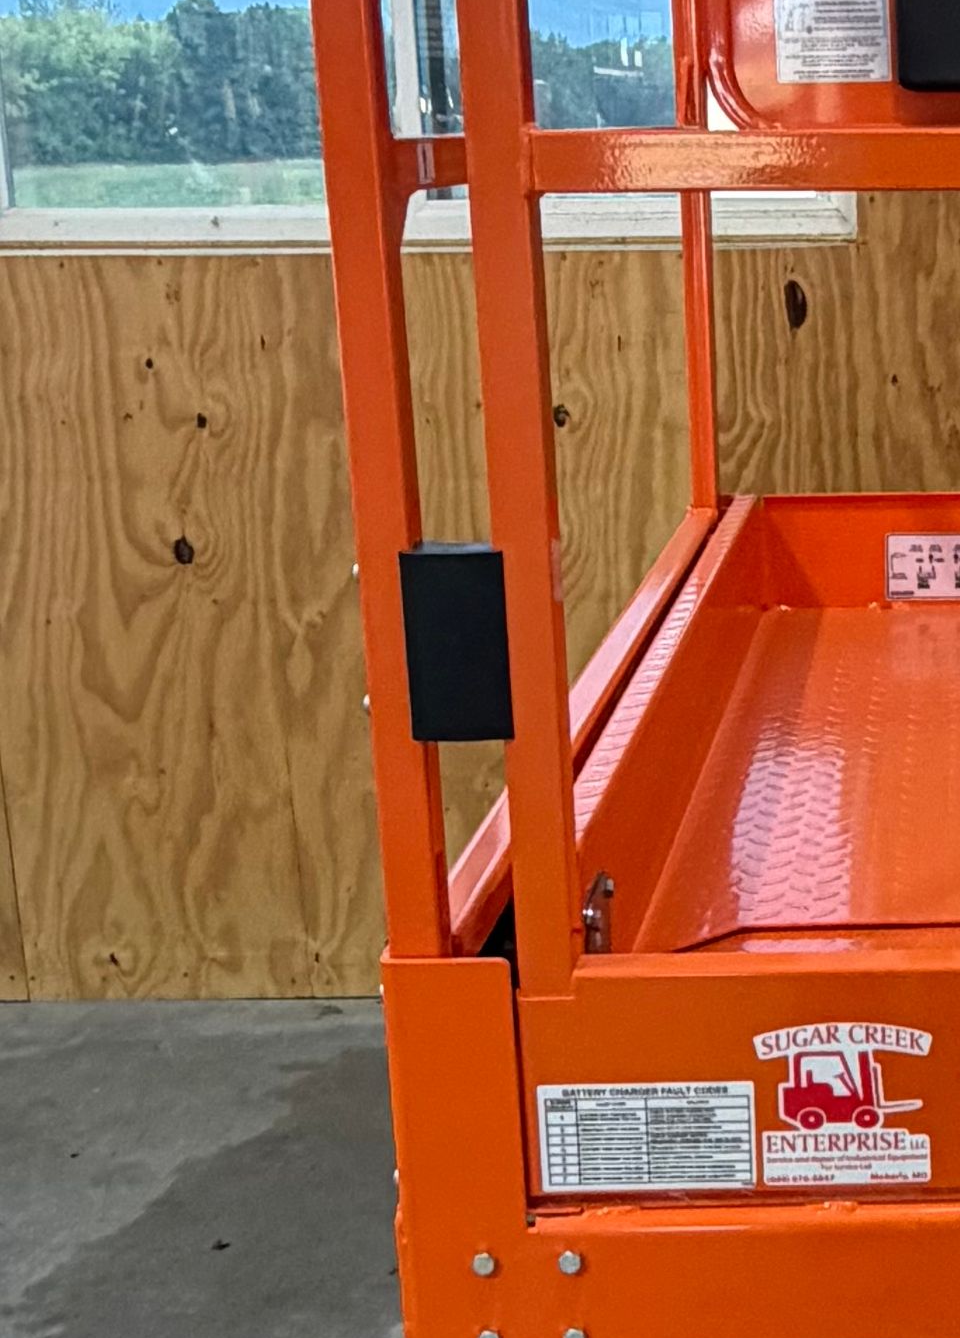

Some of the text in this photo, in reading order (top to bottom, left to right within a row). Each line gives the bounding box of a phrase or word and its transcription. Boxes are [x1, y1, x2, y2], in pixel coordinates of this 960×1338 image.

[761, 1024, 925, 1056] SUGAR CREEK
[562, 1088, 606, 1098] BATTERY
[765, 1131, 927, 1154] ENTERPRISE LLC
